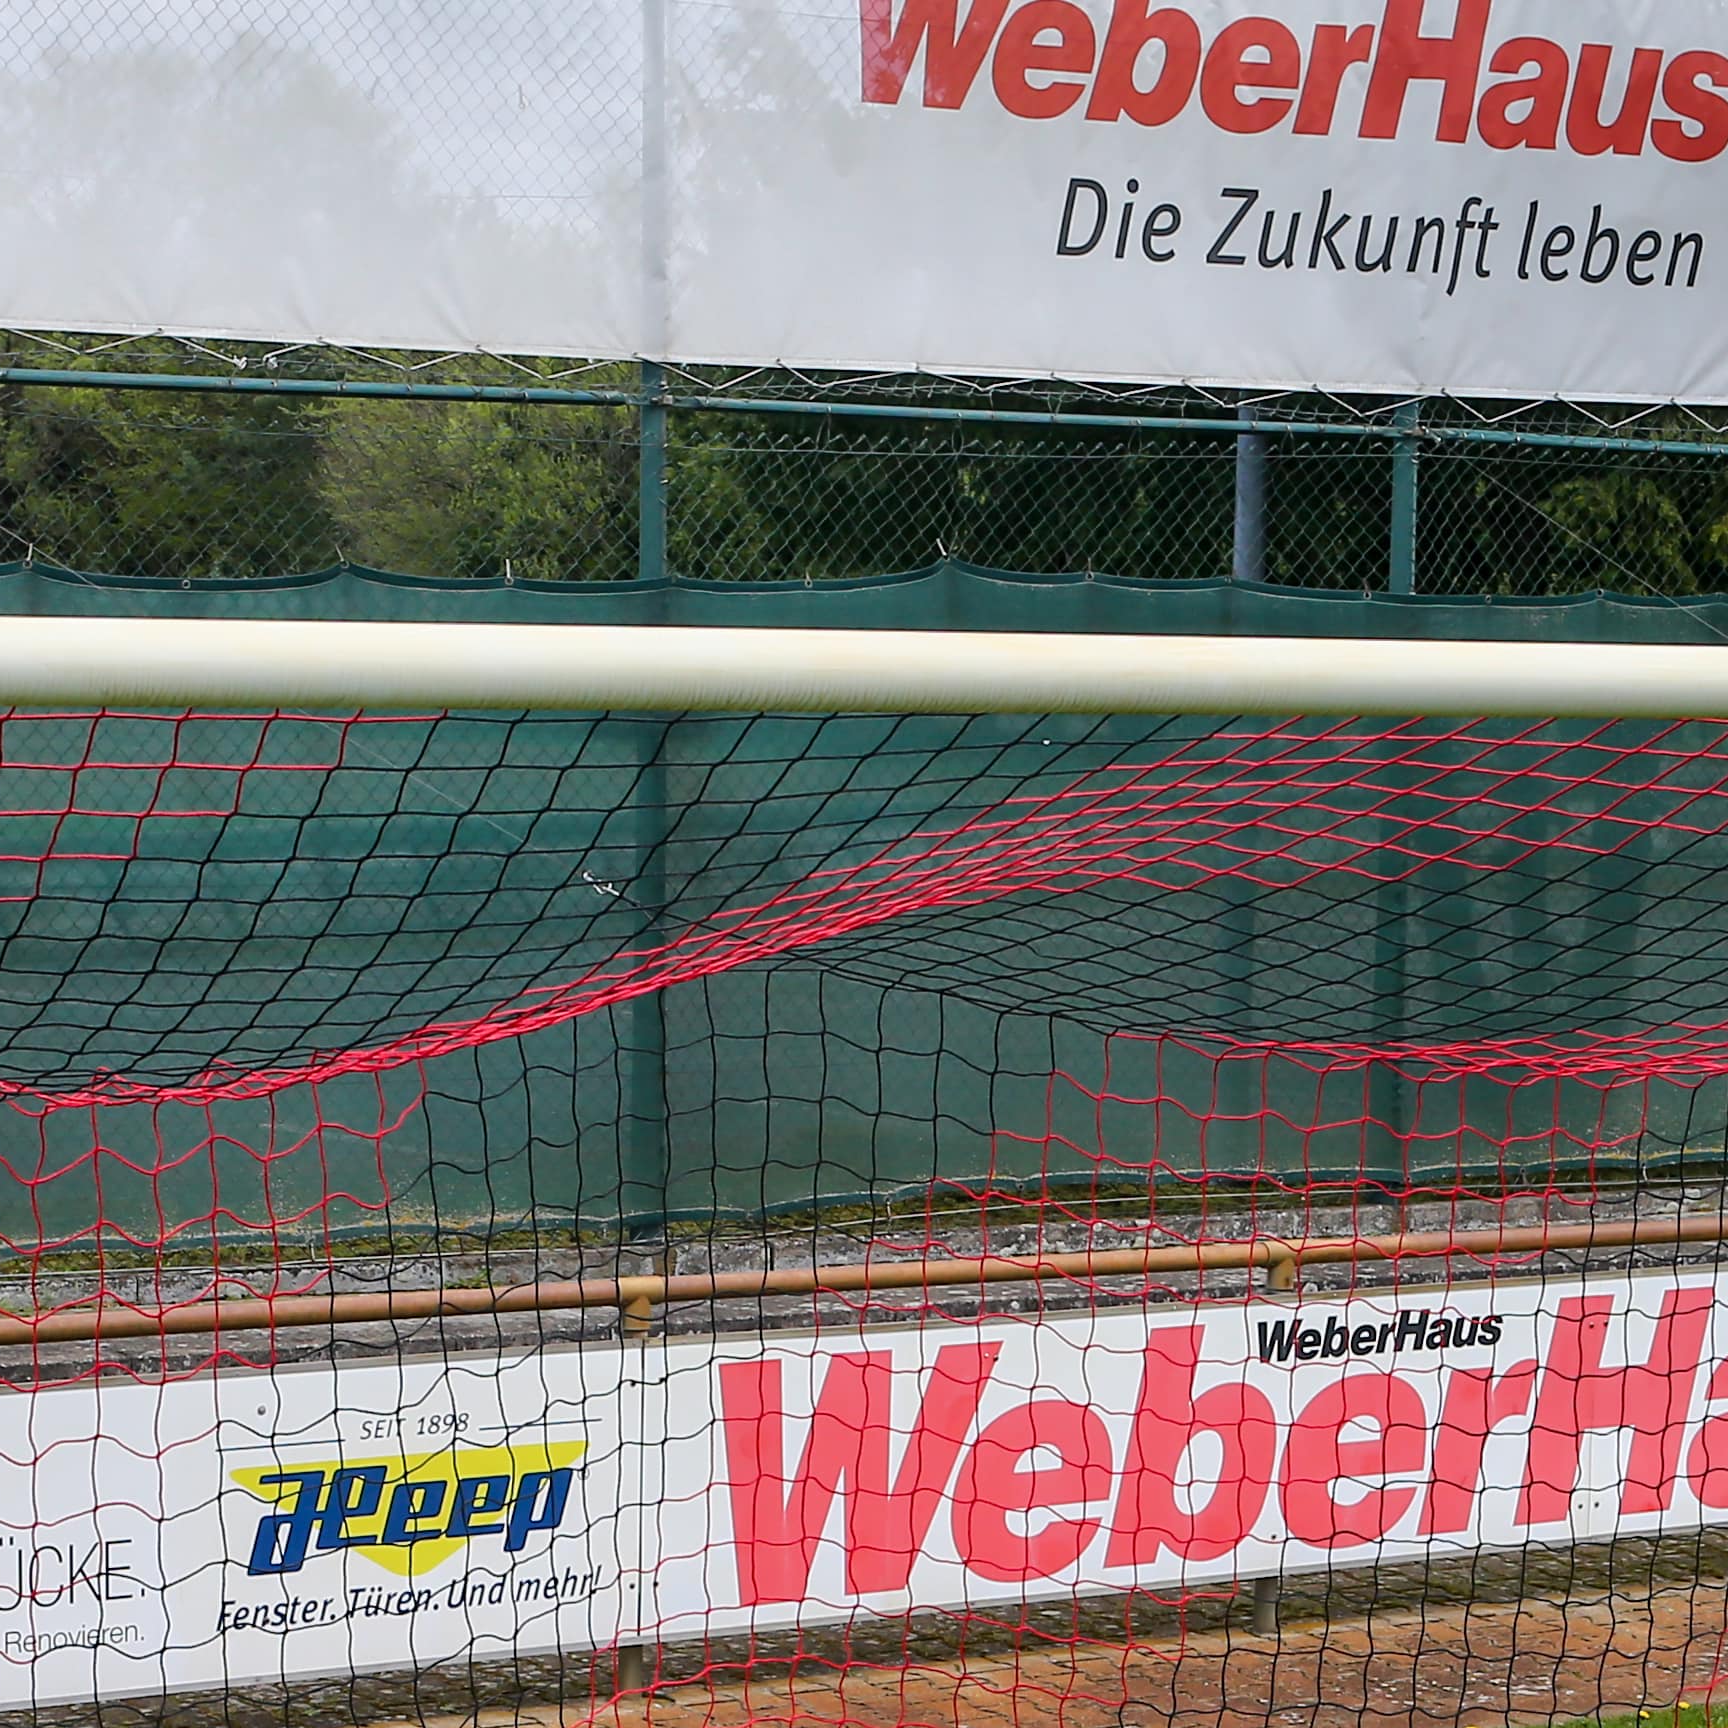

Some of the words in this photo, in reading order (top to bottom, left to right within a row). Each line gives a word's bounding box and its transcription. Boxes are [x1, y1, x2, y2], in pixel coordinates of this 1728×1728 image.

[1056, 177, 1183, 262] Die
[1205, 187, 1499, 296] Zukunft
[1518, 199, 1706, 288] leben
[1256, 1308, 1504, 1363] WeberHaus
[360, 1417, 406, 1440] SEIT
[416, 1412, 470, 1436] 1898
[216, 1595, 337, 1631] Fenster.
[348, 1584, 440, 1620] Türen.
[446, 1578, 505, 1608] Und
[516, 1565, 603, 1601] mehr!
[4, 1623, 146, 1654] Renovieren.
